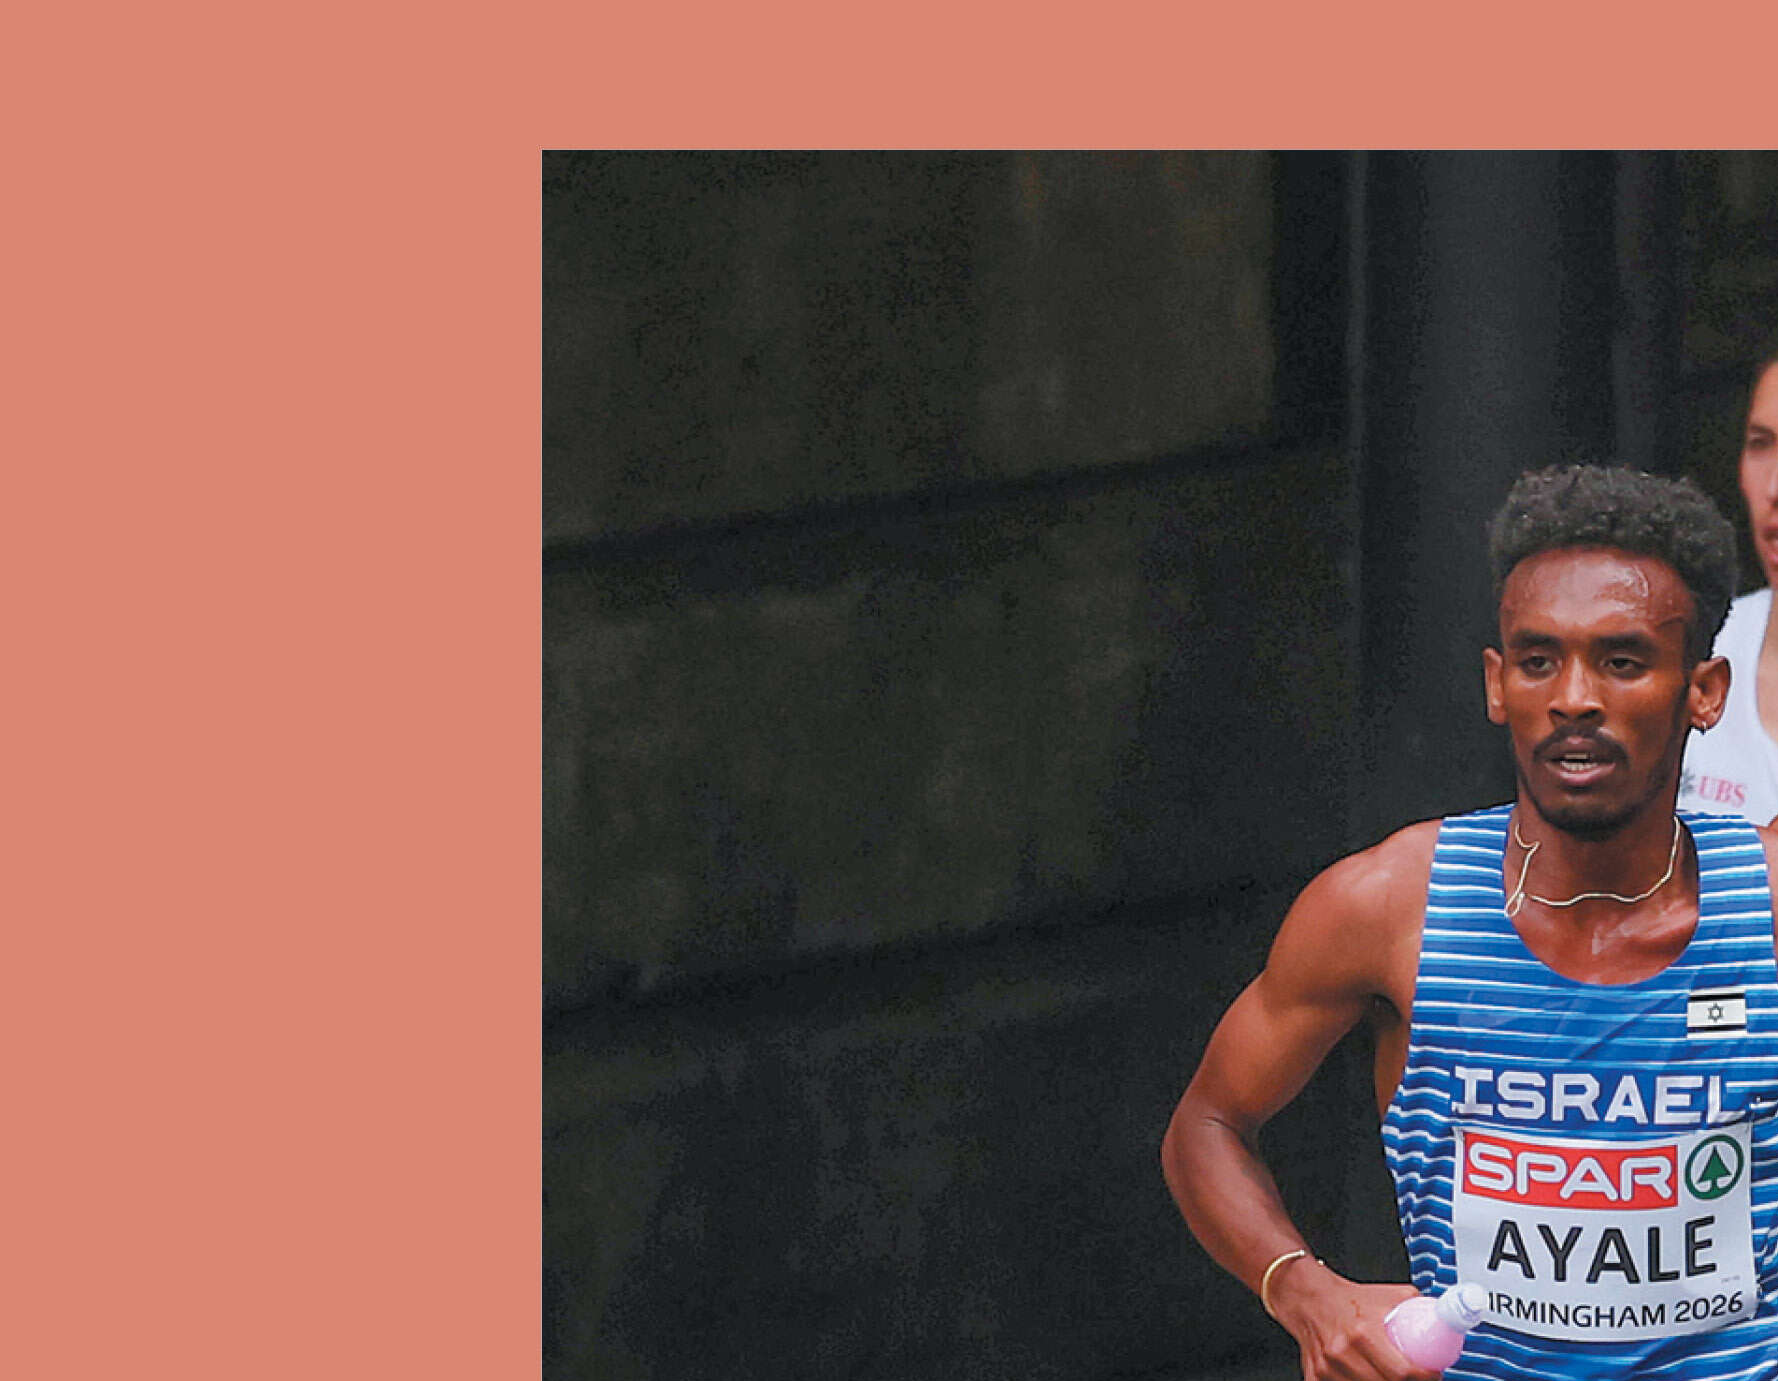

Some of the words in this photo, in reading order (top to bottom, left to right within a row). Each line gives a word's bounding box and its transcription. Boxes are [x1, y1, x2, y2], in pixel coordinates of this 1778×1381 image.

[1700, 775, 1747, 809] UBS
[1452, 1066, 1746, 1126] ISRAEL
[1468, 1142, 1673, 1201] SPAR
[1486, 1215, 1718, 1284] AYALE
[1488, 1291, 1666, 1328] IRMINGHAM
[1673, 1290, 1743, 1323] 2026
